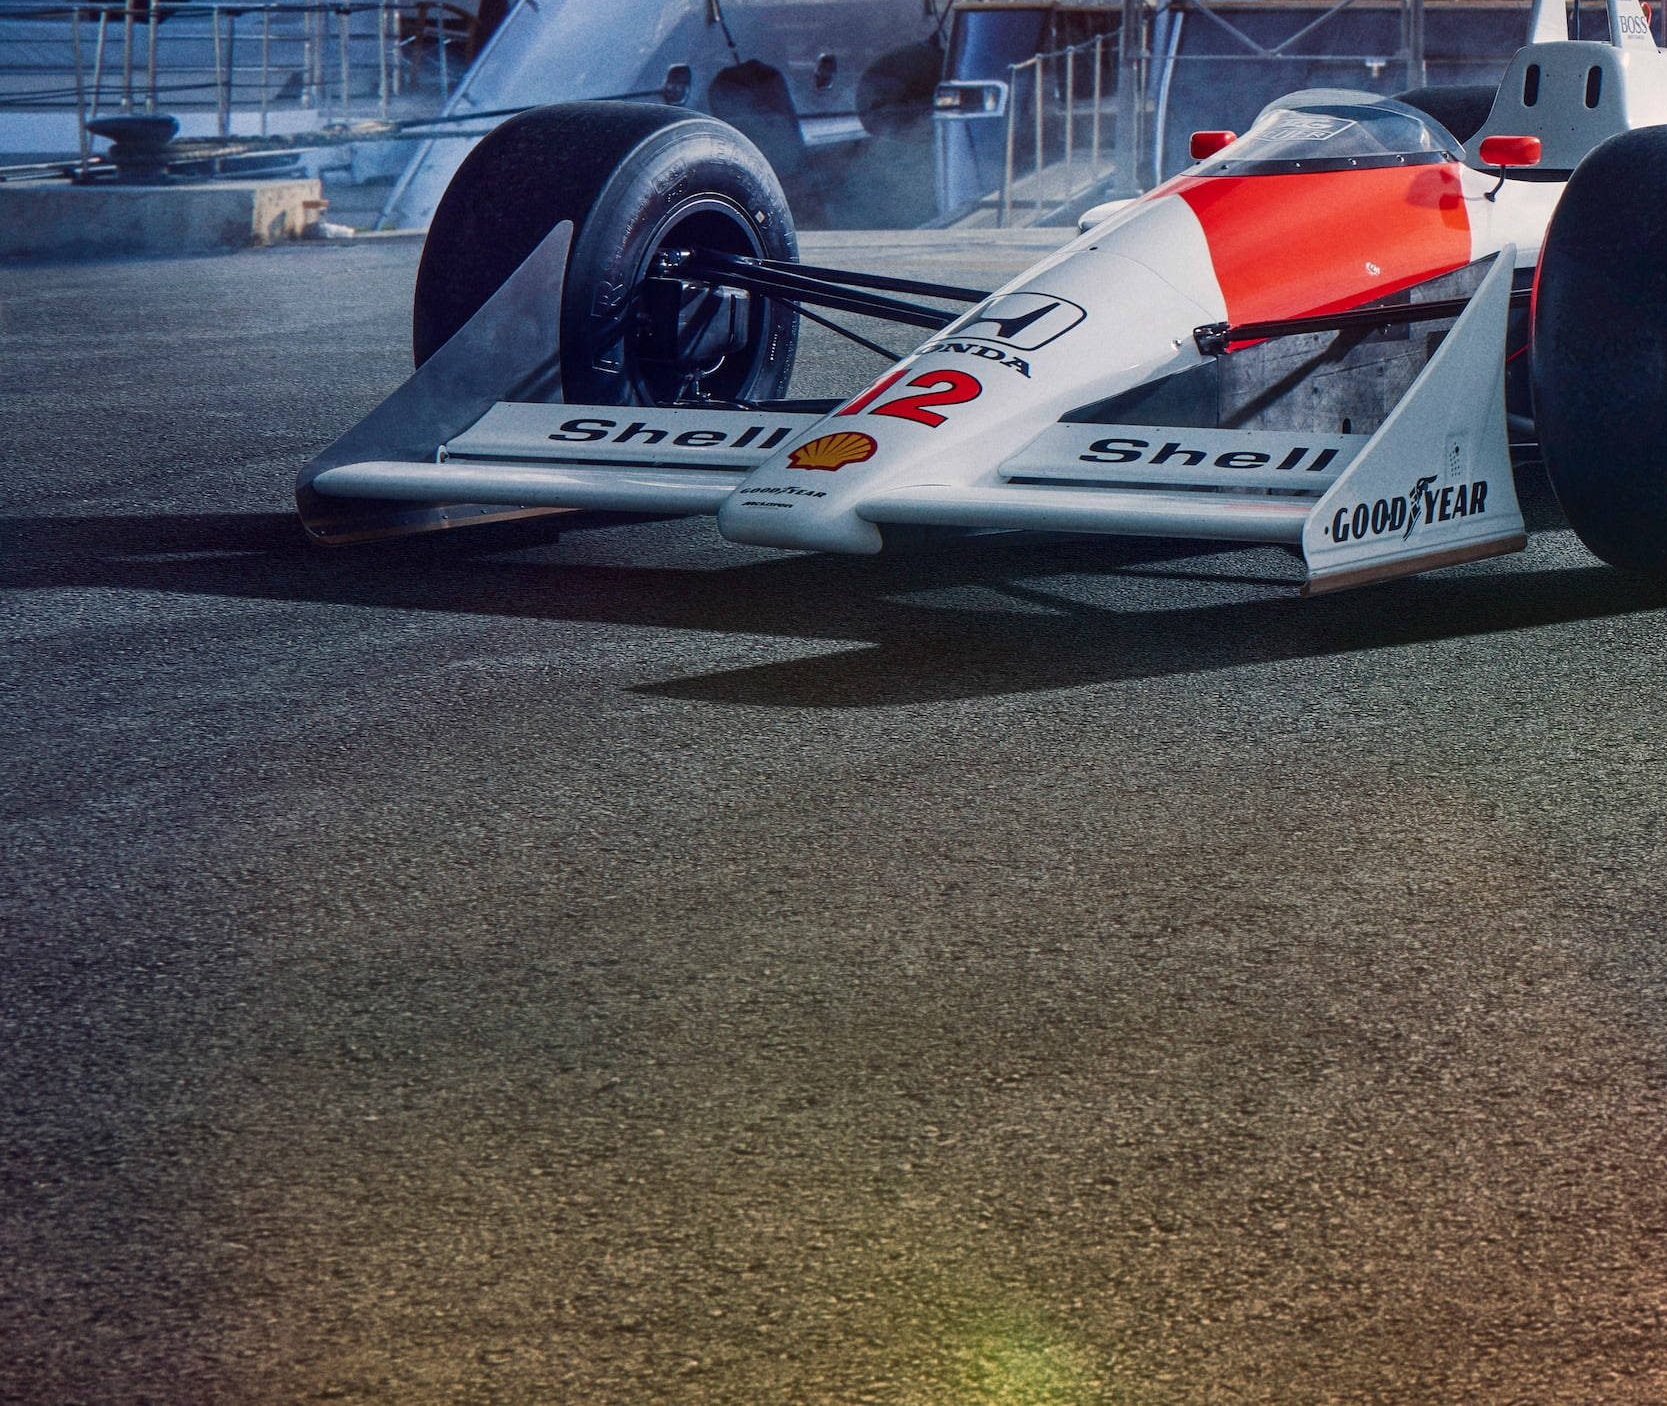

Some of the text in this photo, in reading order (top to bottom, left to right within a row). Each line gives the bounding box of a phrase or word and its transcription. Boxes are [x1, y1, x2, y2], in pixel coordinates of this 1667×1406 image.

[1620, 15, 1648, 34] BOSS
[915, 342, 1032, 379] ONDA
[833, 368, 983, 428] 12
[547, 418, 793, 449] Shell
[1078, 438, 1340, 472] Shell
